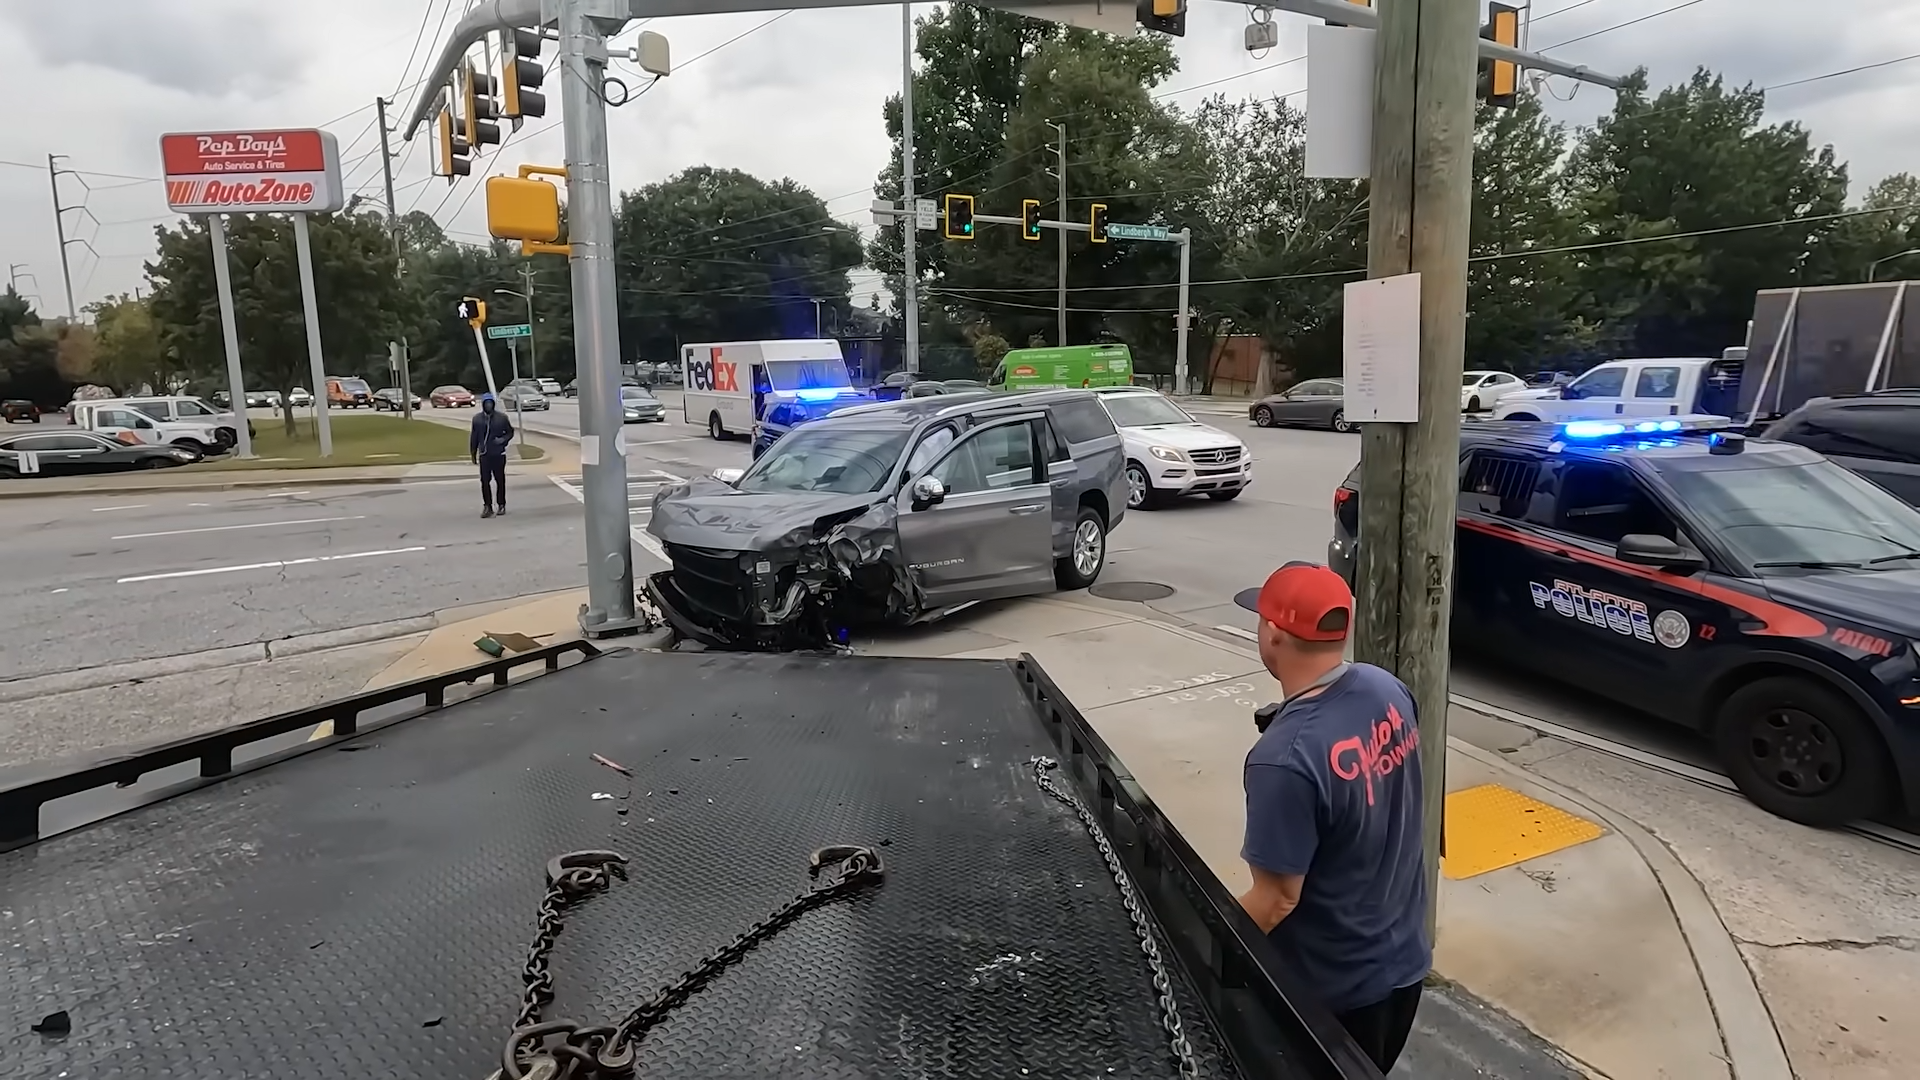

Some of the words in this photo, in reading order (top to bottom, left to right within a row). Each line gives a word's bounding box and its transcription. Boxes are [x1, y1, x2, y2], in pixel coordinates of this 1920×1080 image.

[197, 136, 235, 156] Pep
[236, 135, 287, 157] Boys
[204, 162, 223, 170] Auto
[225, 161, 255, 170] Service
[257, 161, 263, 169] &
[265, 160, 285, 169] Tires
[202, 179, 314, 205] AutoZone
[1121, 226, 1151, 239] Lindbergh
[1153, 228, 1166, 239] Way
[686, 347, 739, 391] FedEx
[1554, 579, 1648, 614] ATLANTA
[1530, 581, 1656, 644] POLICE
[1831, 627, 1892, 658] PATROL
